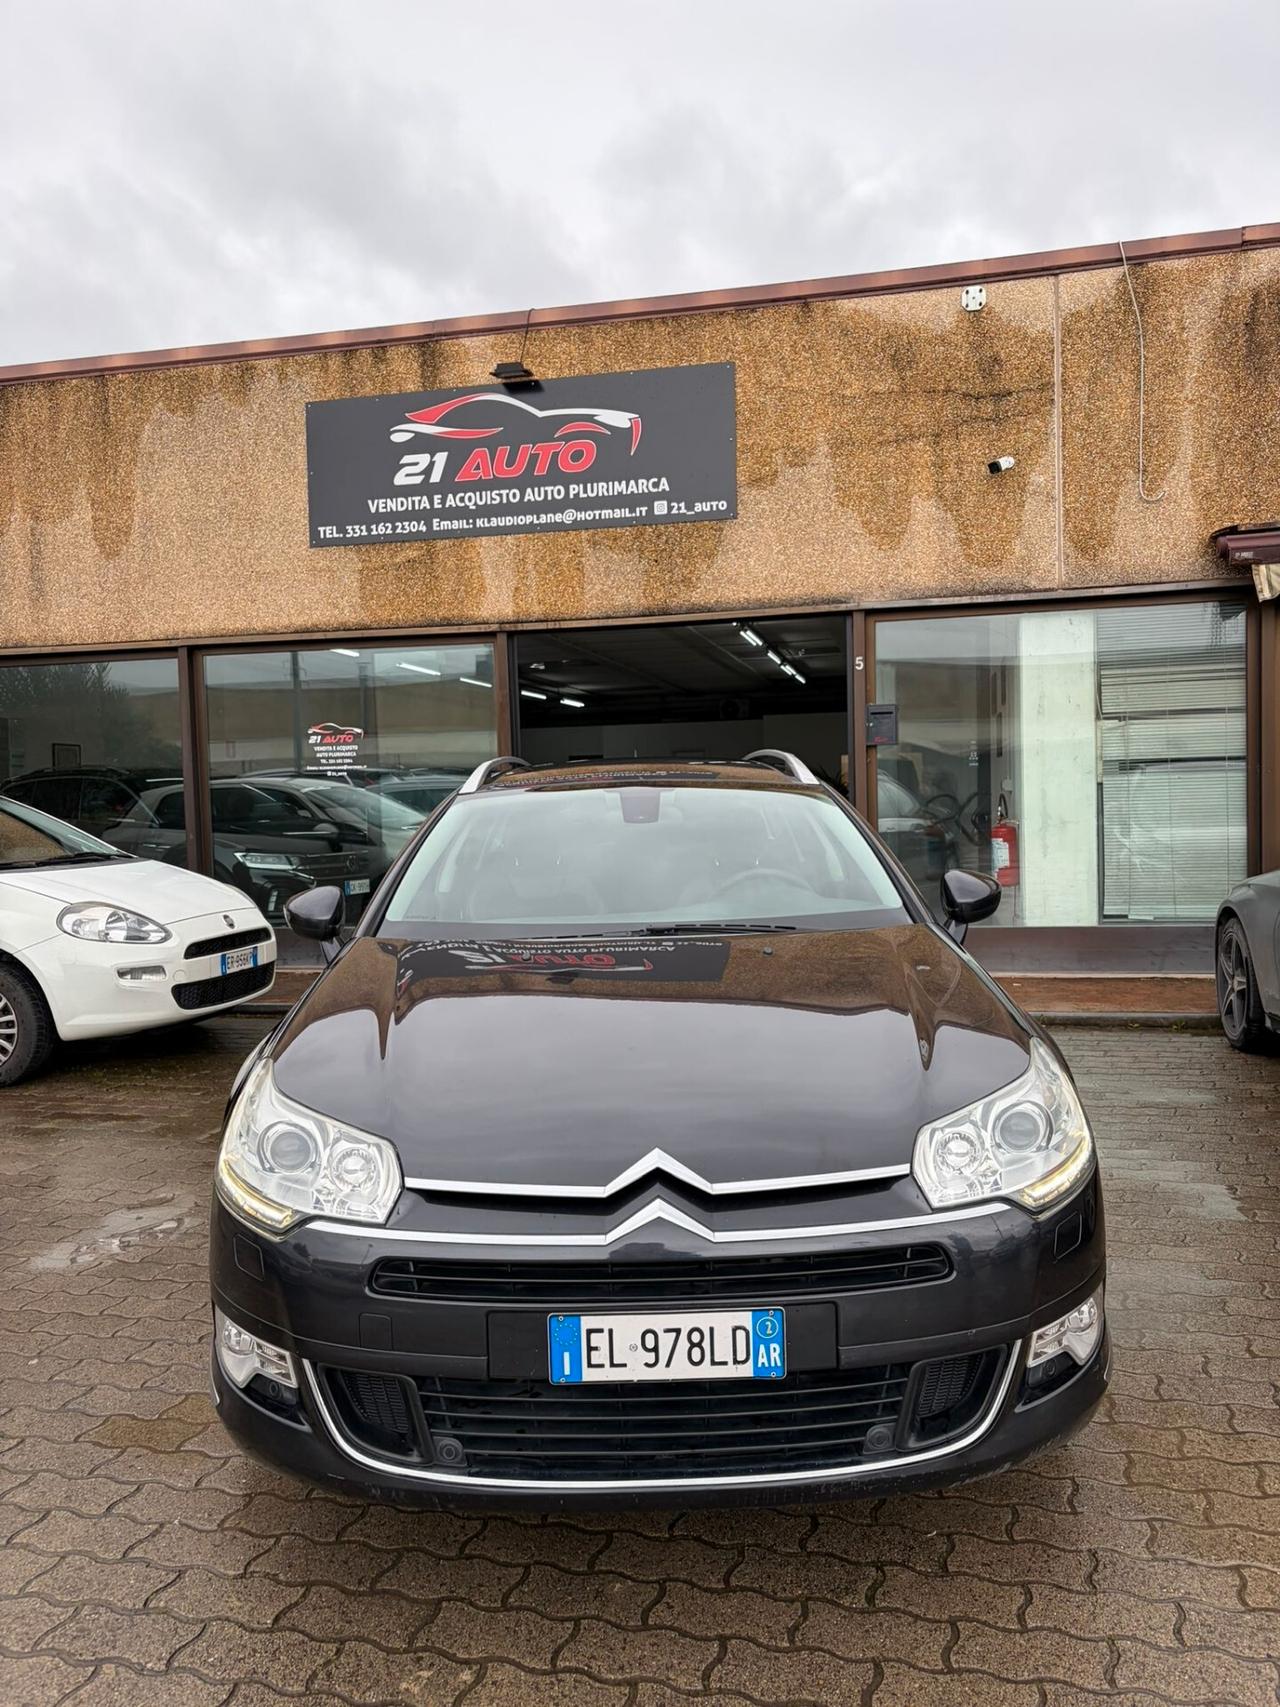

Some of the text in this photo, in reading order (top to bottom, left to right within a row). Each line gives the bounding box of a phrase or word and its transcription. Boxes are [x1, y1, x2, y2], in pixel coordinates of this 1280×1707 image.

[393, 439, 597, 486] 21 AUTO
[367, 477, 670, 514] VENDITA E ACQUISTO AUTO PLURIMARCA
[318, 526, 343, 539] TEL.
[345, 524, 368, 538] 331
[371, 522, 392, 535] 162
[396, 520, 427, 534] 2304
[855, 656, 864, 670] 5
[308, 735, 354, 744] 21 AUTO
[765, 1321, 773, 1335] 2
[757, 1343, 782, 1368] AR
